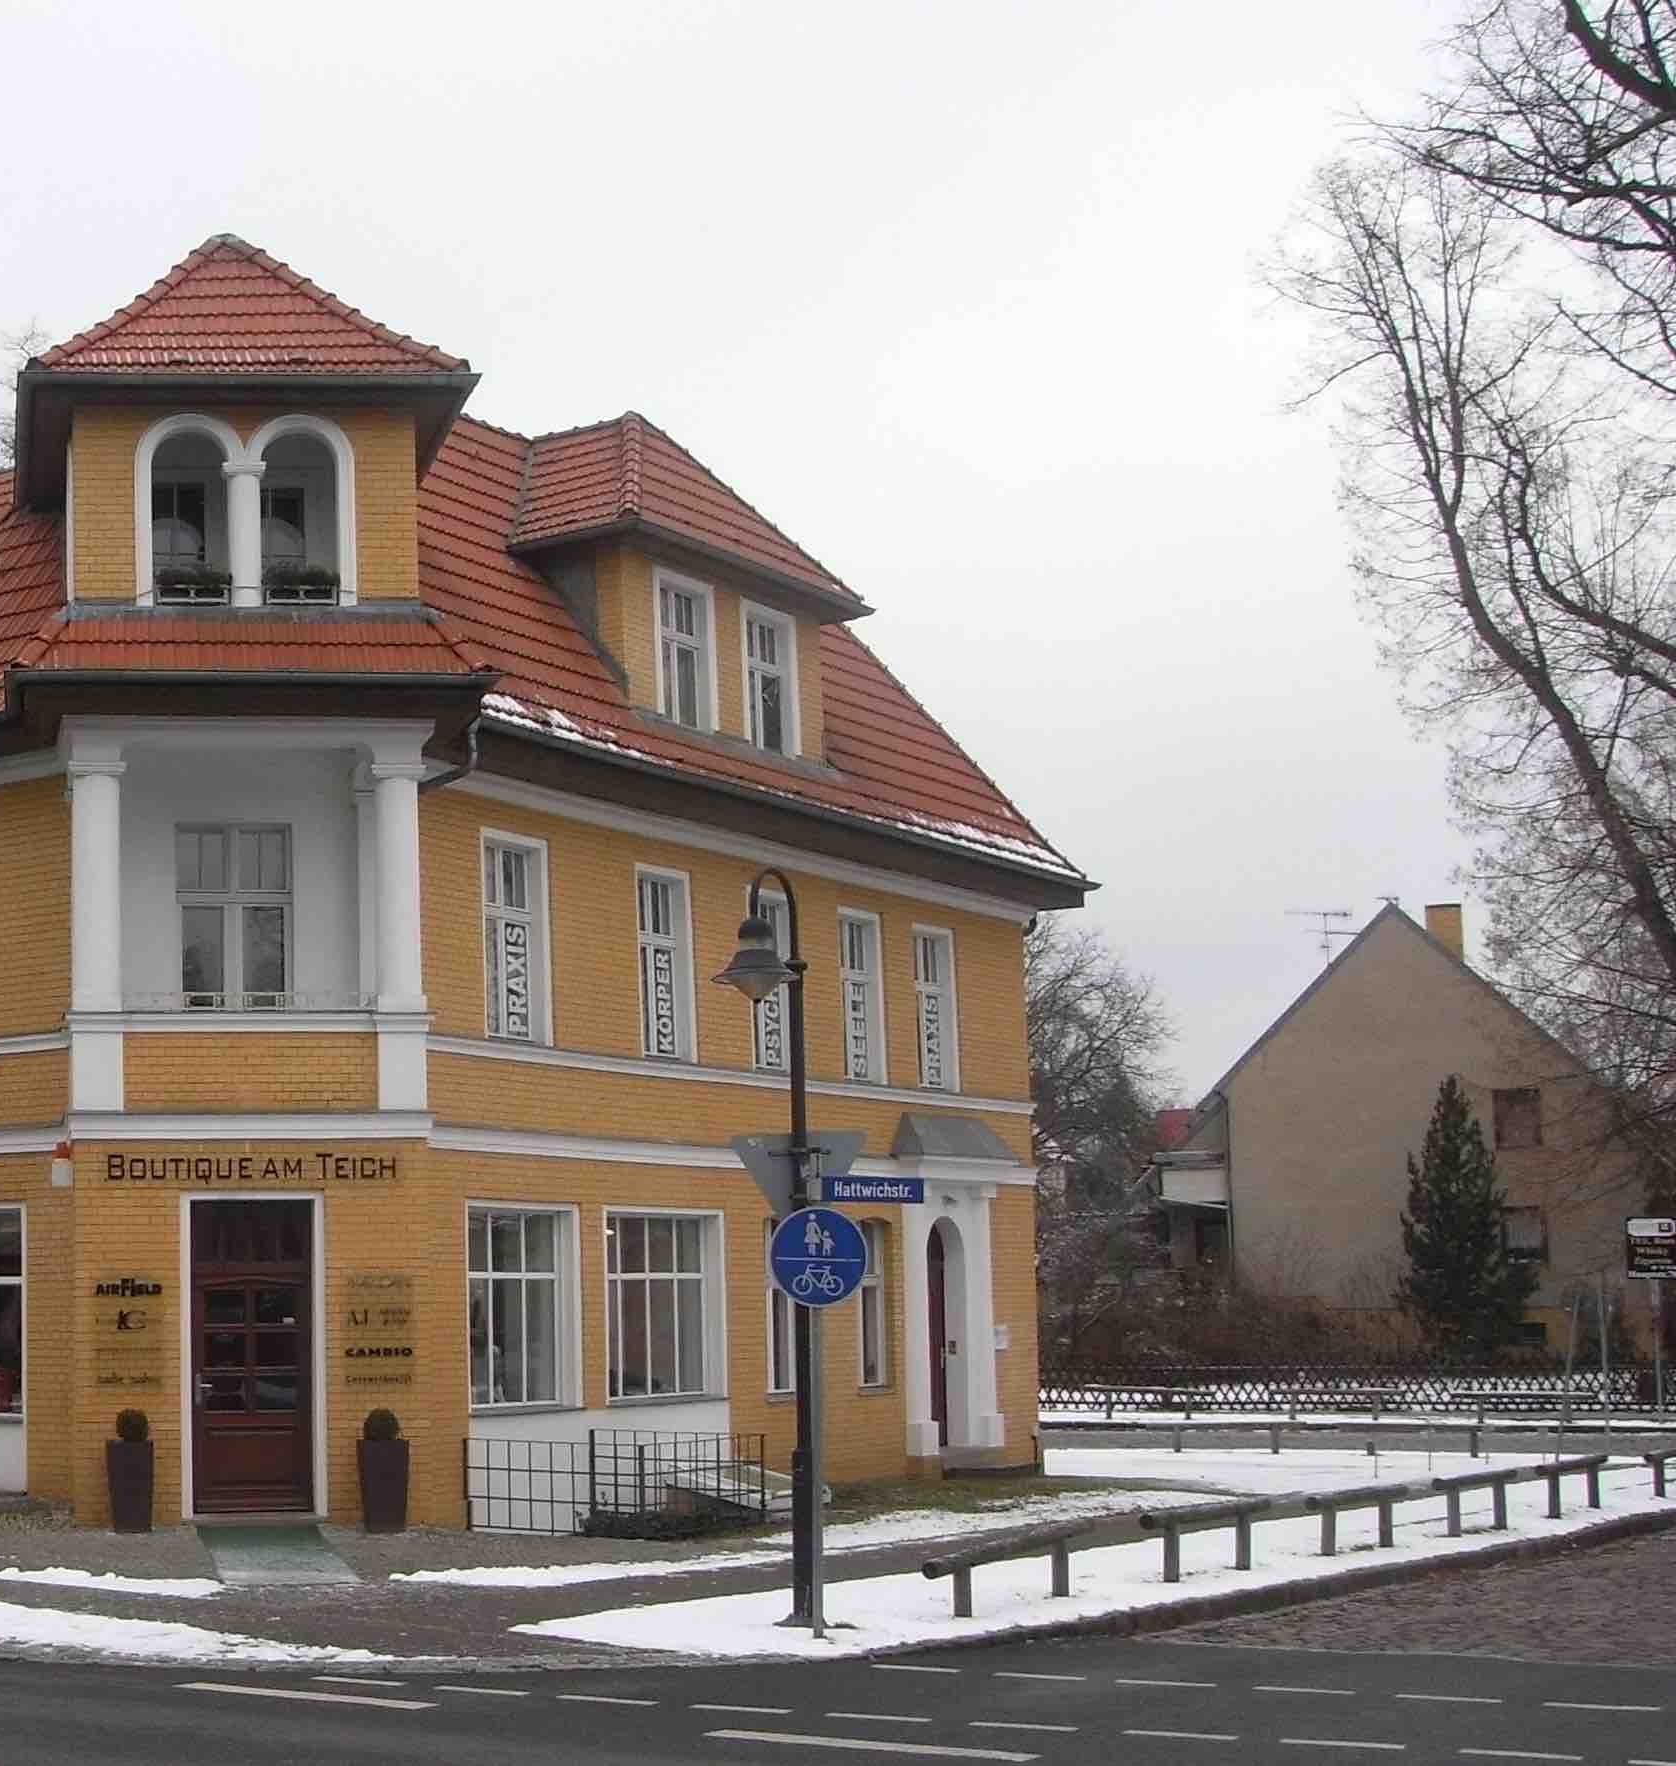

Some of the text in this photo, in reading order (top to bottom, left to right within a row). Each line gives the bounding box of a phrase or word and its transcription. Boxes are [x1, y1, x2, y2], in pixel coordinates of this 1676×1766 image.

[506, 923, 528, 1034] PRAXIS
[851, 983, 868, 1079] SEELE
[925, 993, 942, 1087] PRAXIS
[107, 1153, 397, 1184] BOUTIQUE AM TEICH
[834, 1181, 914, 1198] Hattwichstr.
